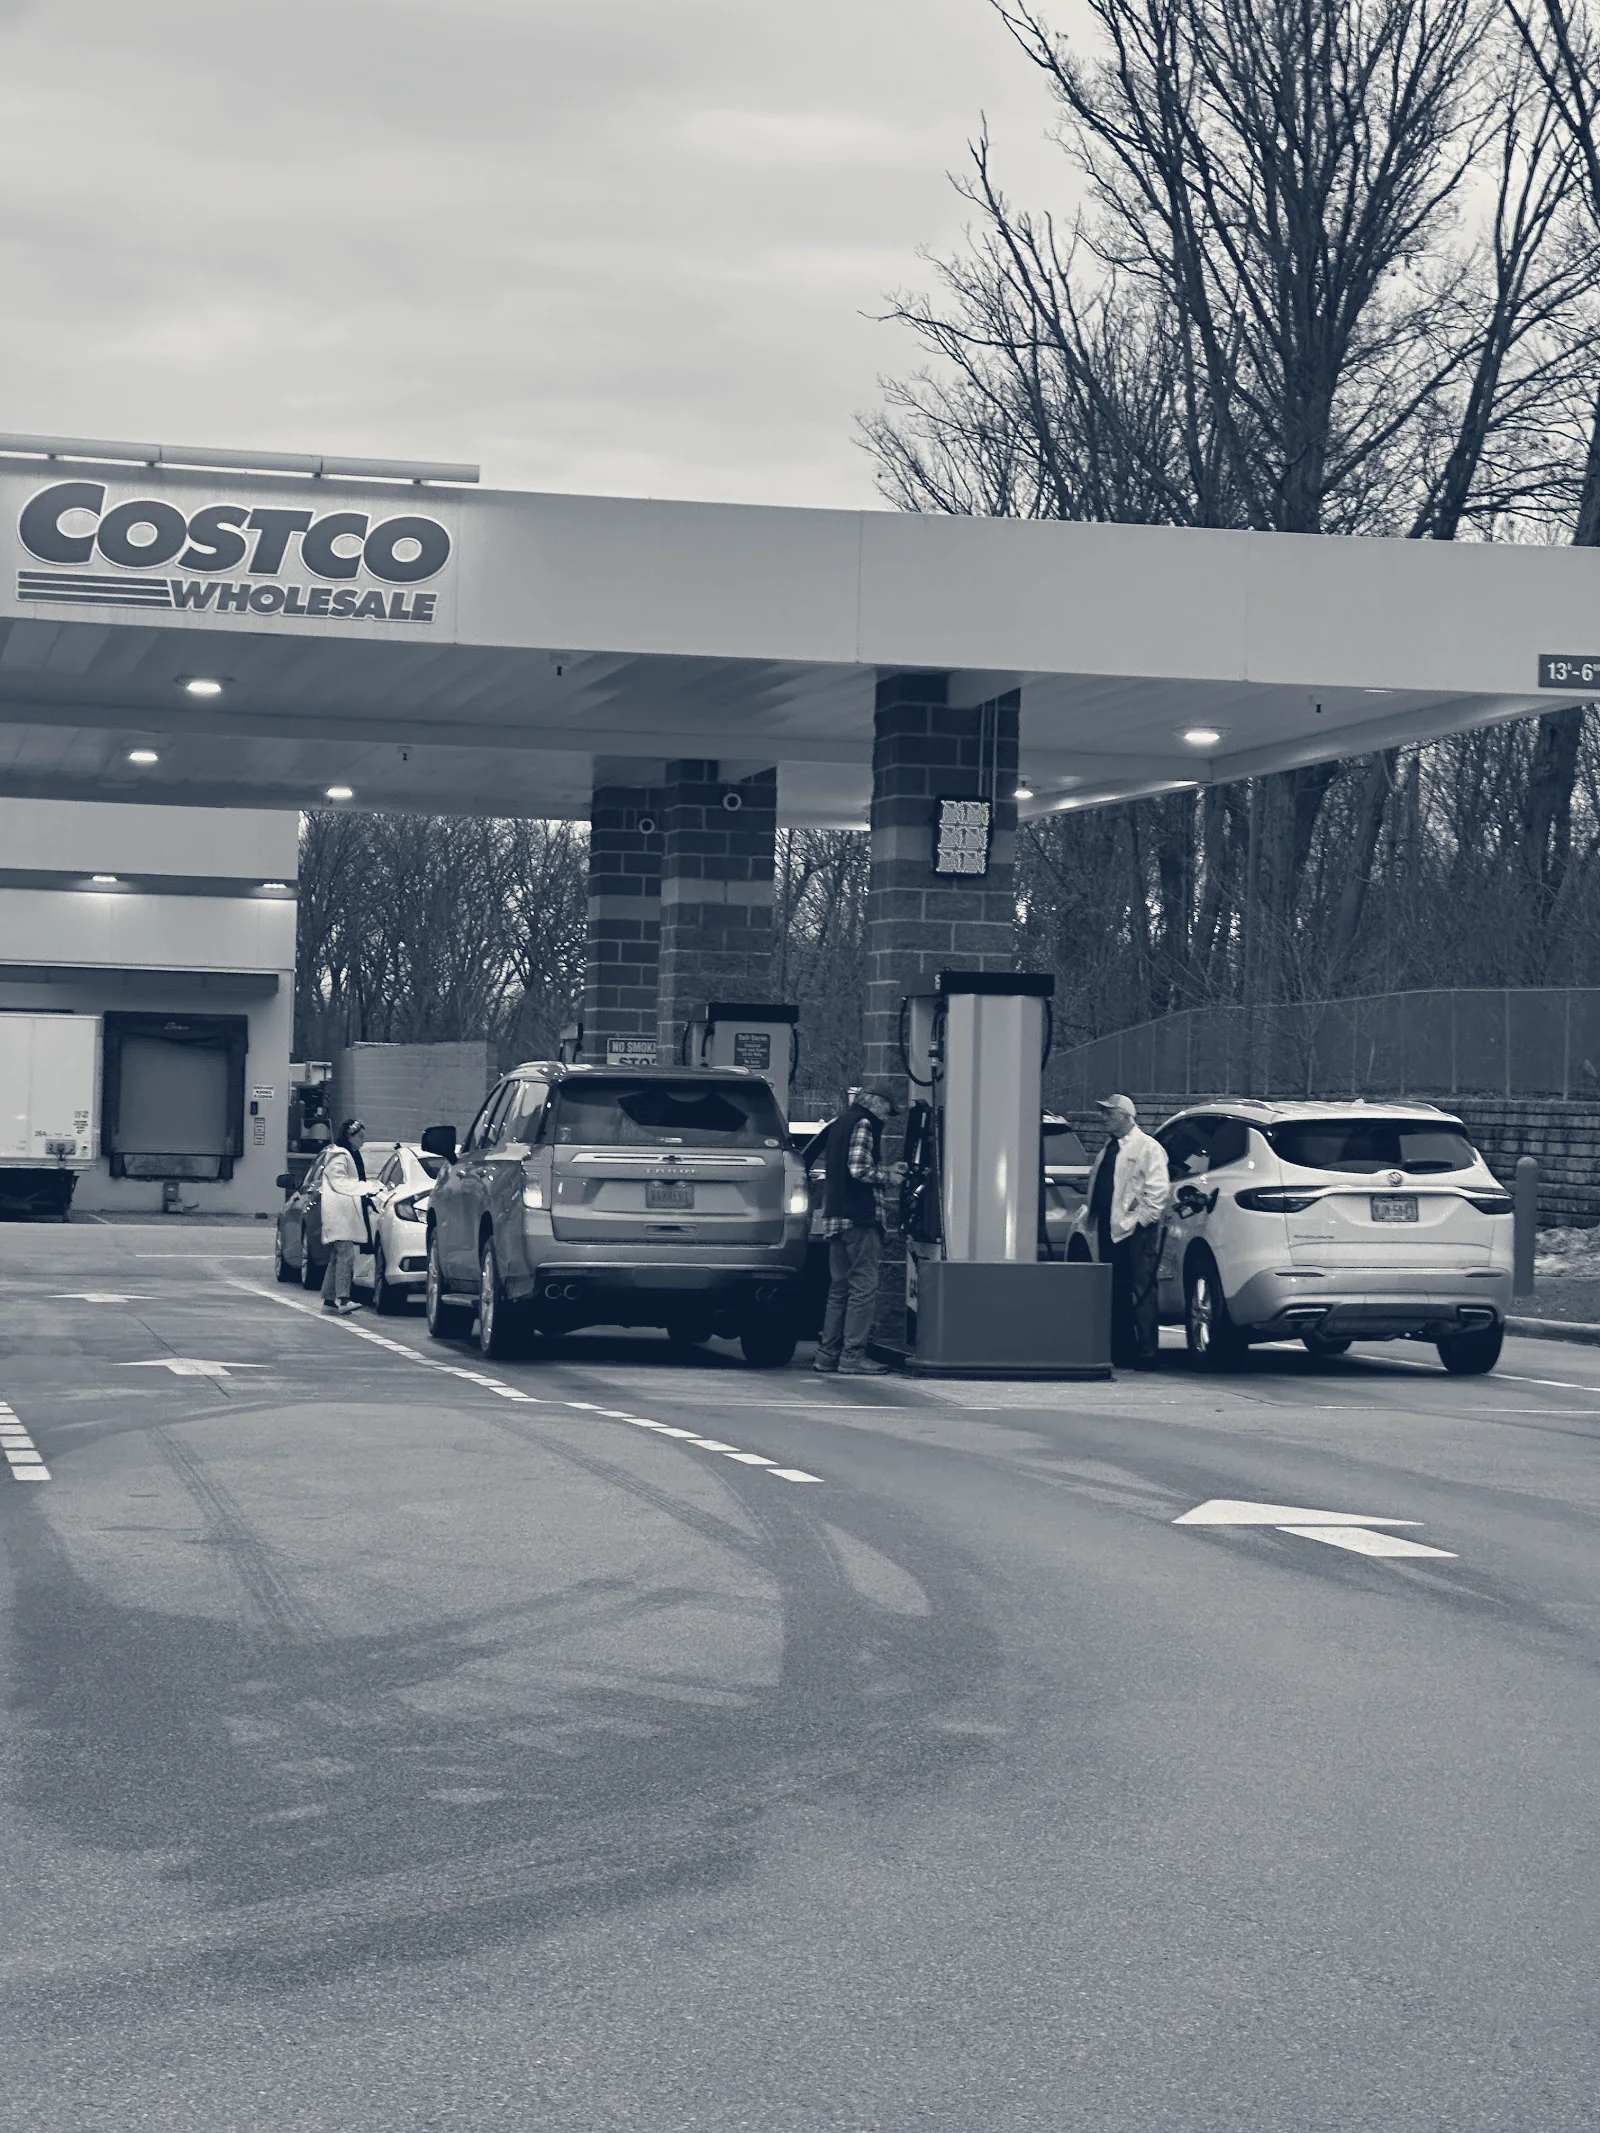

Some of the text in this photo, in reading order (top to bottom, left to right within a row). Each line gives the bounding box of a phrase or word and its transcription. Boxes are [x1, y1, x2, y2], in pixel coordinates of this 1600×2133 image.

[17, 480, 453, 585] COSTCO
[168, 578, 439, 622] WHOLESALE
[612, 1041, 625, 1053] NO
